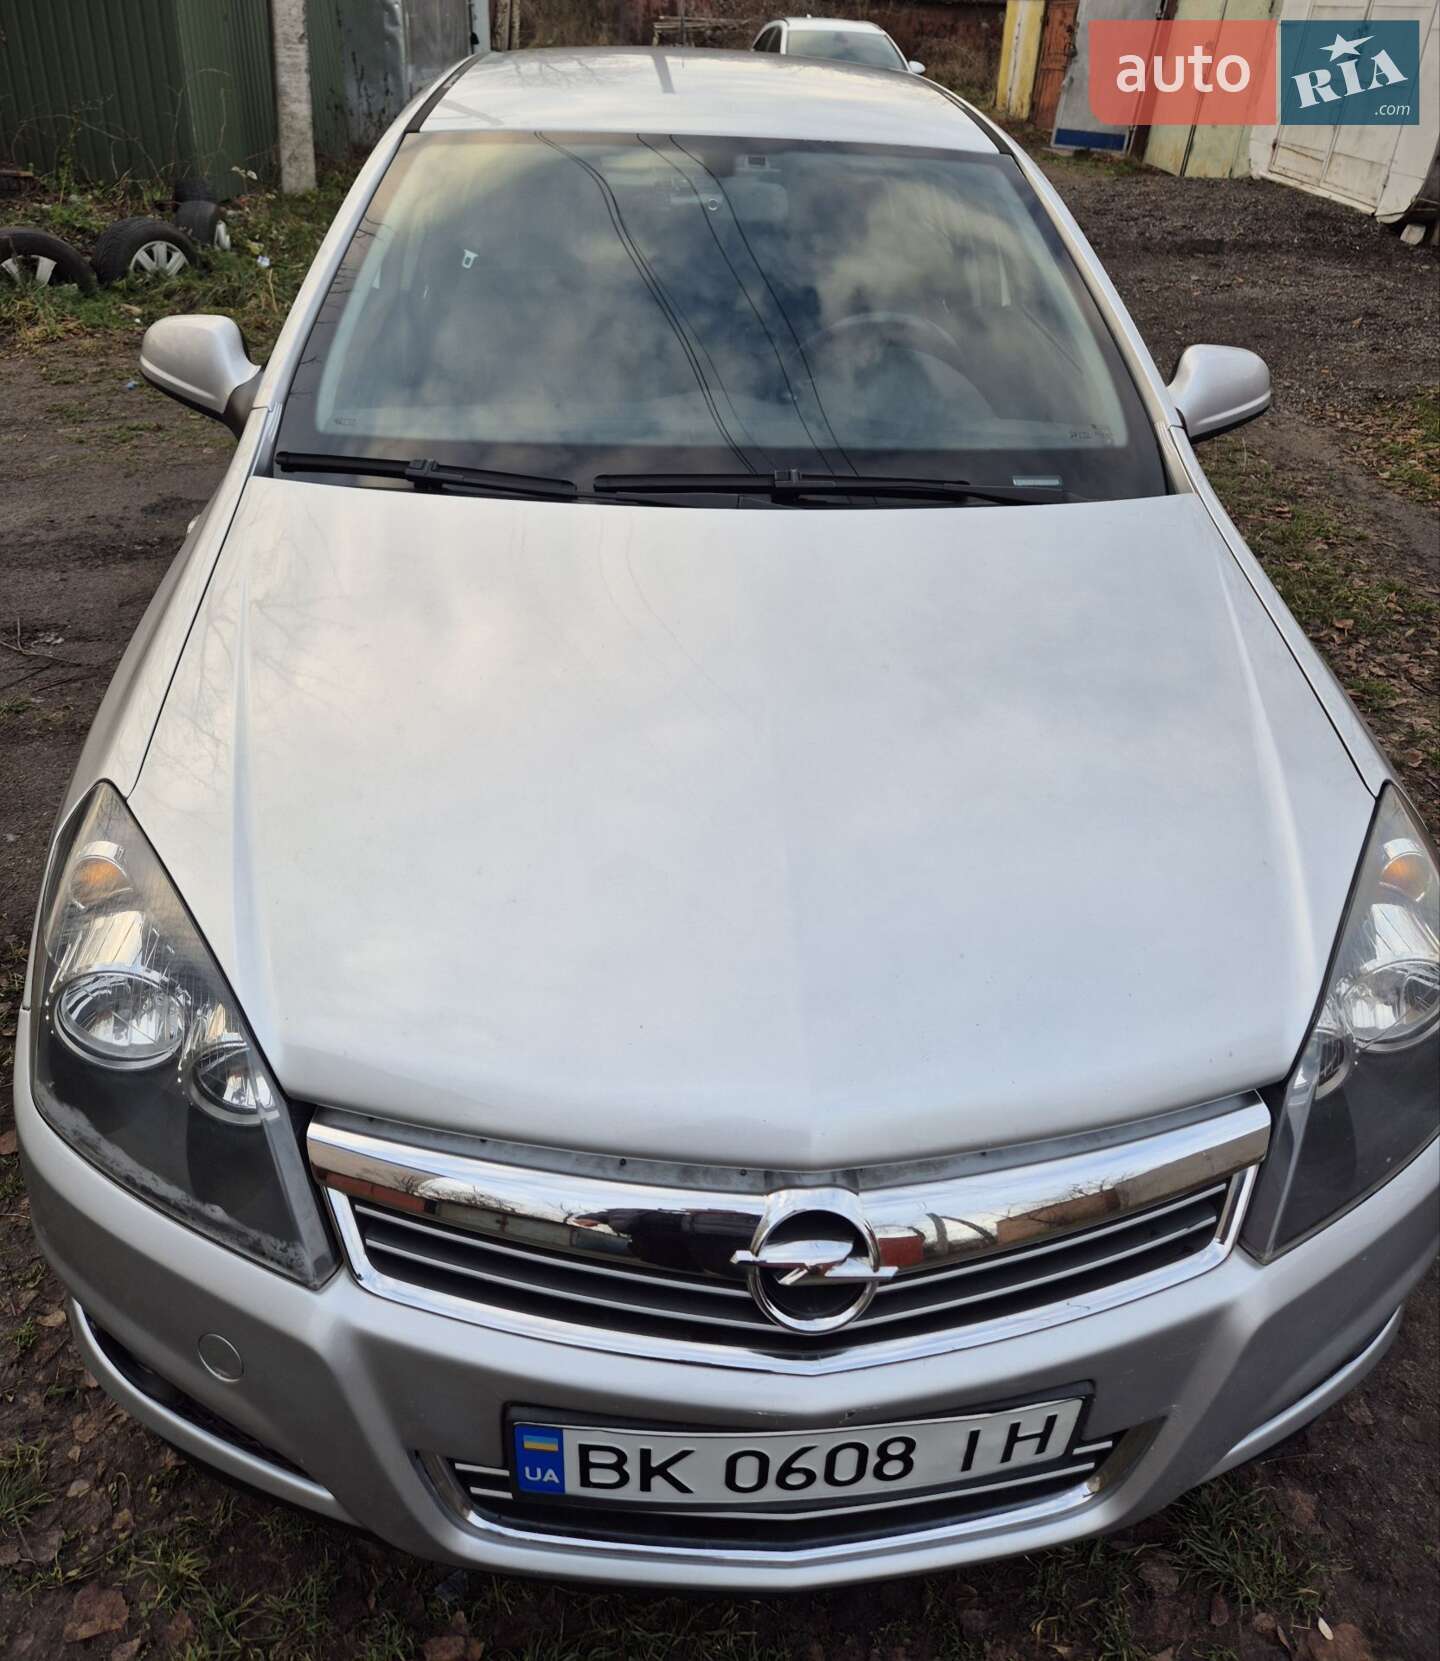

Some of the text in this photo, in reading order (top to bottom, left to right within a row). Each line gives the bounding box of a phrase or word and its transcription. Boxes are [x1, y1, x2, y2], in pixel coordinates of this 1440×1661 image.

[524, 1466, 560, 1485] UA
[577, 1413, 1059, 1495] BK 0608 IH
